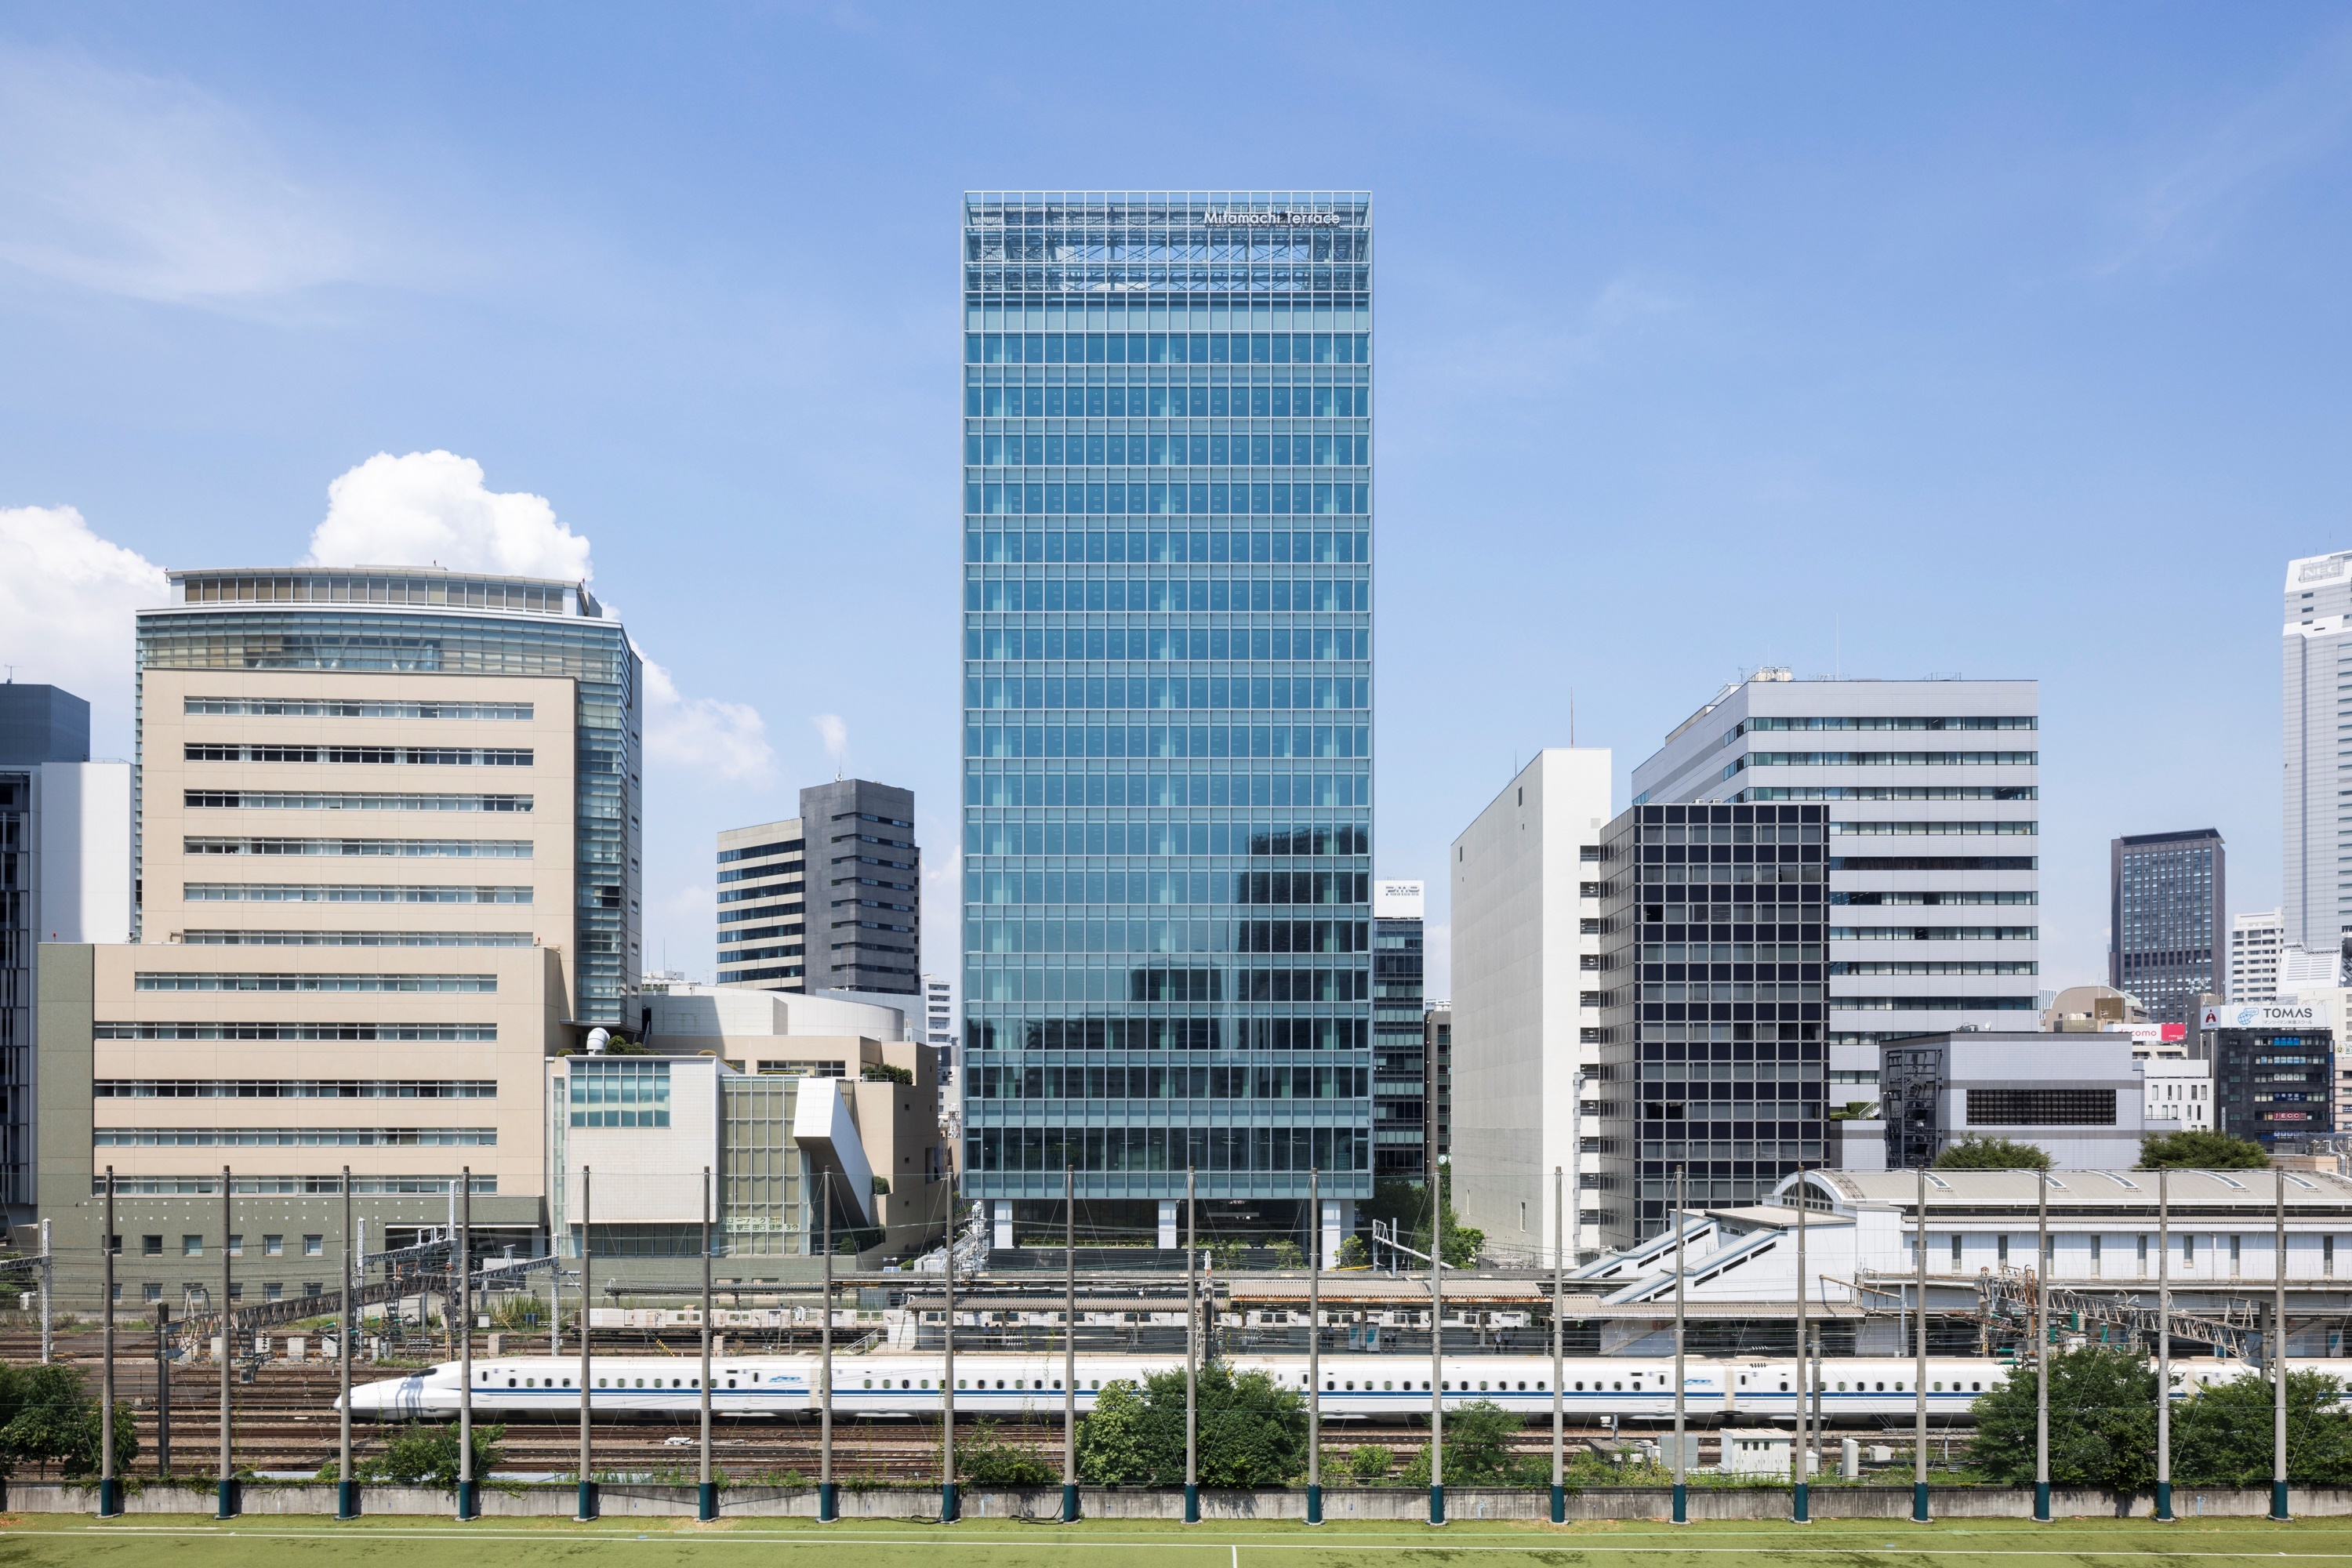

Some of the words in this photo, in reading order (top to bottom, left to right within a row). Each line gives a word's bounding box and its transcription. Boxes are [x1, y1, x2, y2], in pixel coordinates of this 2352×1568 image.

[1203, 209, 1280, 224] Mitamachi
[1285, 210, 1340, 224] Terrace
[2304, 564, 2339, 578] NEC
[2263, 1007, 2313, 1018] TOMAS
